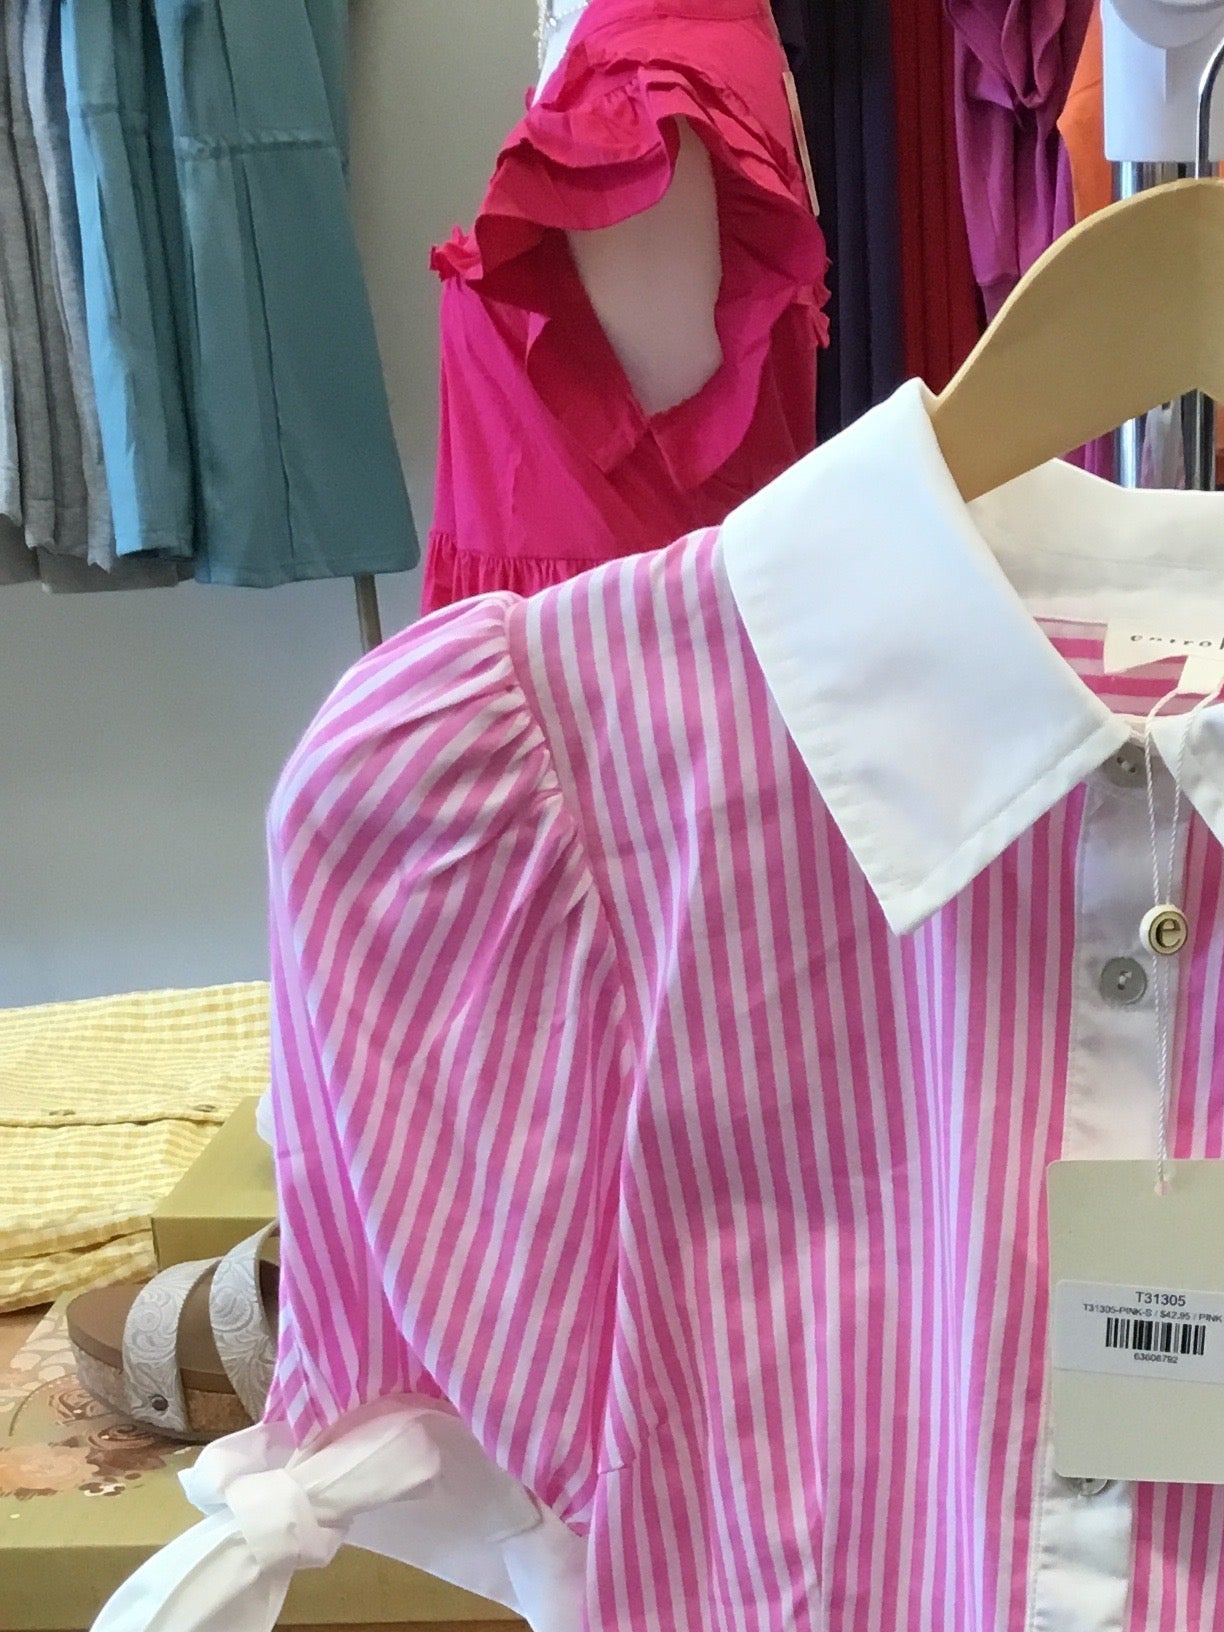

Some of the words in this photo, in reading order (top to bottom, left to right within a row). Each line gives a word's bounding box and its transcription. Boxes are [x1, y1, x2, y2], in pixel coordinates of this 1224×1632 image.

[1155, 918, 1181, 949] e
[1135, 1291, 1187, 1307] T31305
[1083, 1303, 1153, 1318] T31305-PINK-S
[1198, 1313, 1223, 1323] PINK
[1133, 1352, 1179, 1364] 63608792
